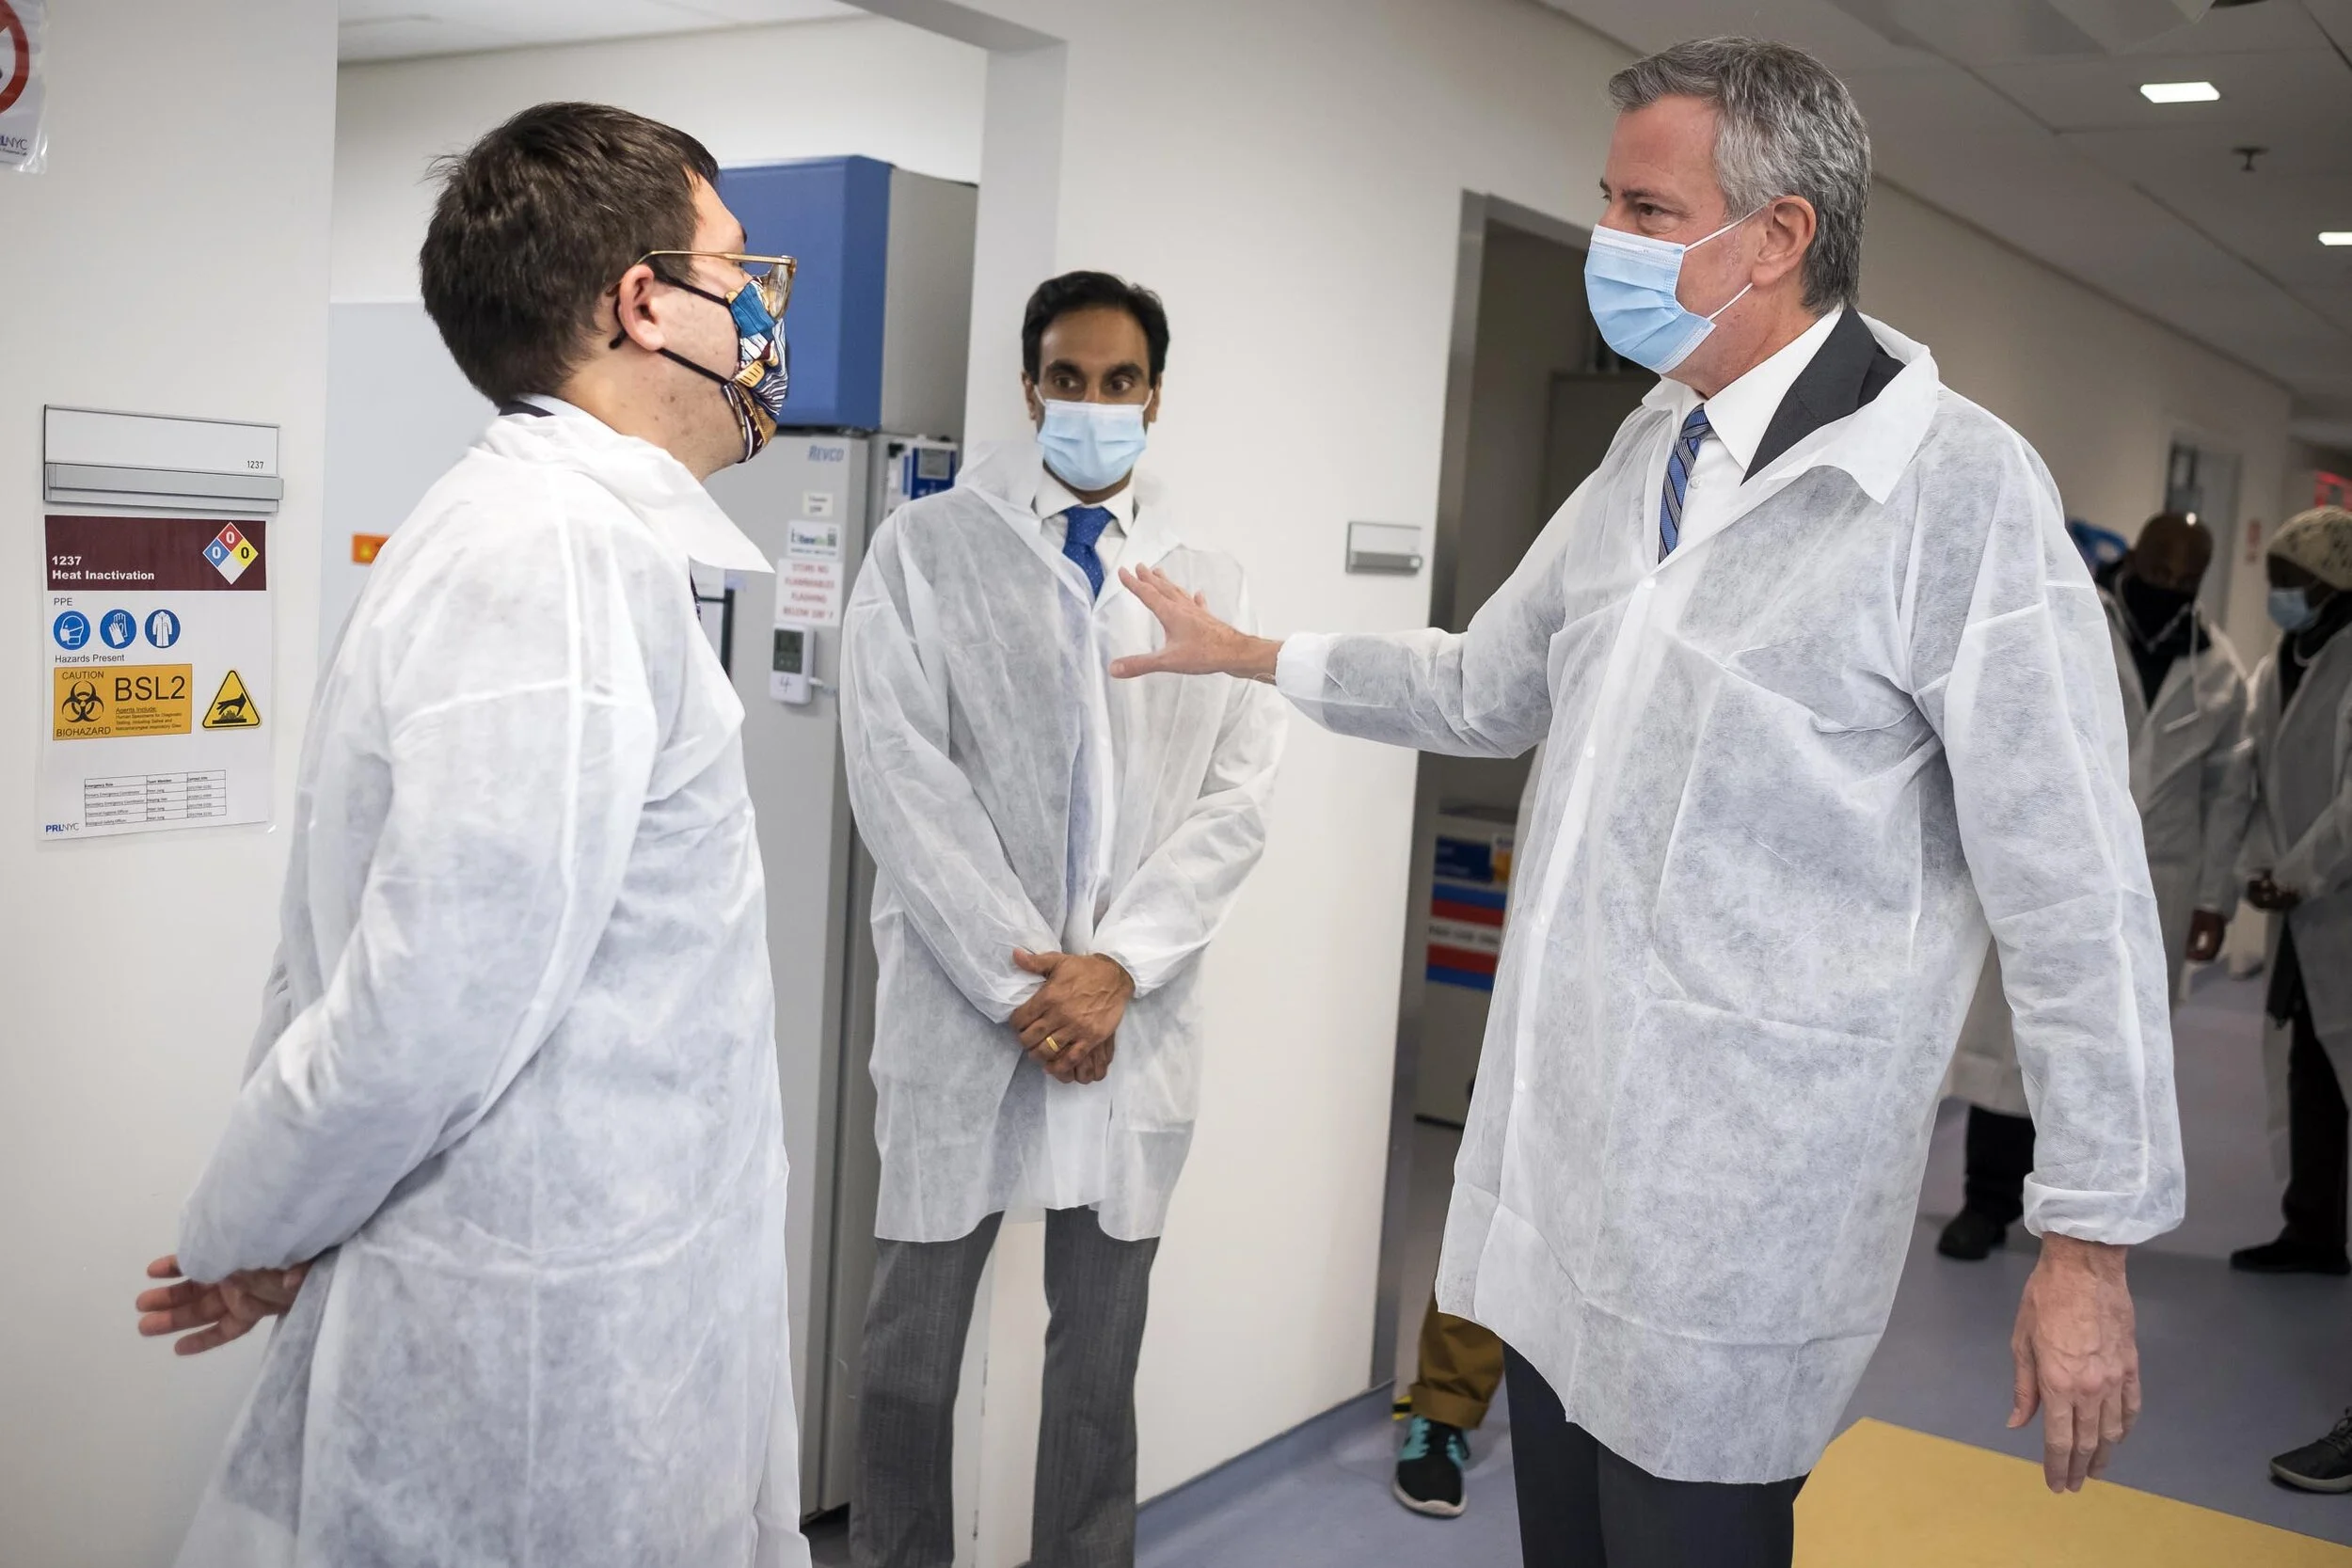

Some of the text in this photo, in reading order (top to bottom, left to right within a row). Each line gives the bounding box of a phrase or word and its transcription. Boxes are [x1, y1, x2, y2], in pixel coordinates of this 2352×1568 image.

[246, 460, 264, 469] 1237
[226, 531, 235, 545] 0
[212, 546, 249, 560] 0 0
[52, 556, 82, 565] 1237
[52, 570, 155, 580] Heat Inactivation
[54, 597, 73, 607] PPE
[55, 654, 125, 663] Hazards Present
[61, 671, 104, 680] CAUTION
[115, 675, 185, 702] BSL2
[56, 726, 111, 737] BIOHAZARD
[46, 823, 79, 832] PRLNYC
